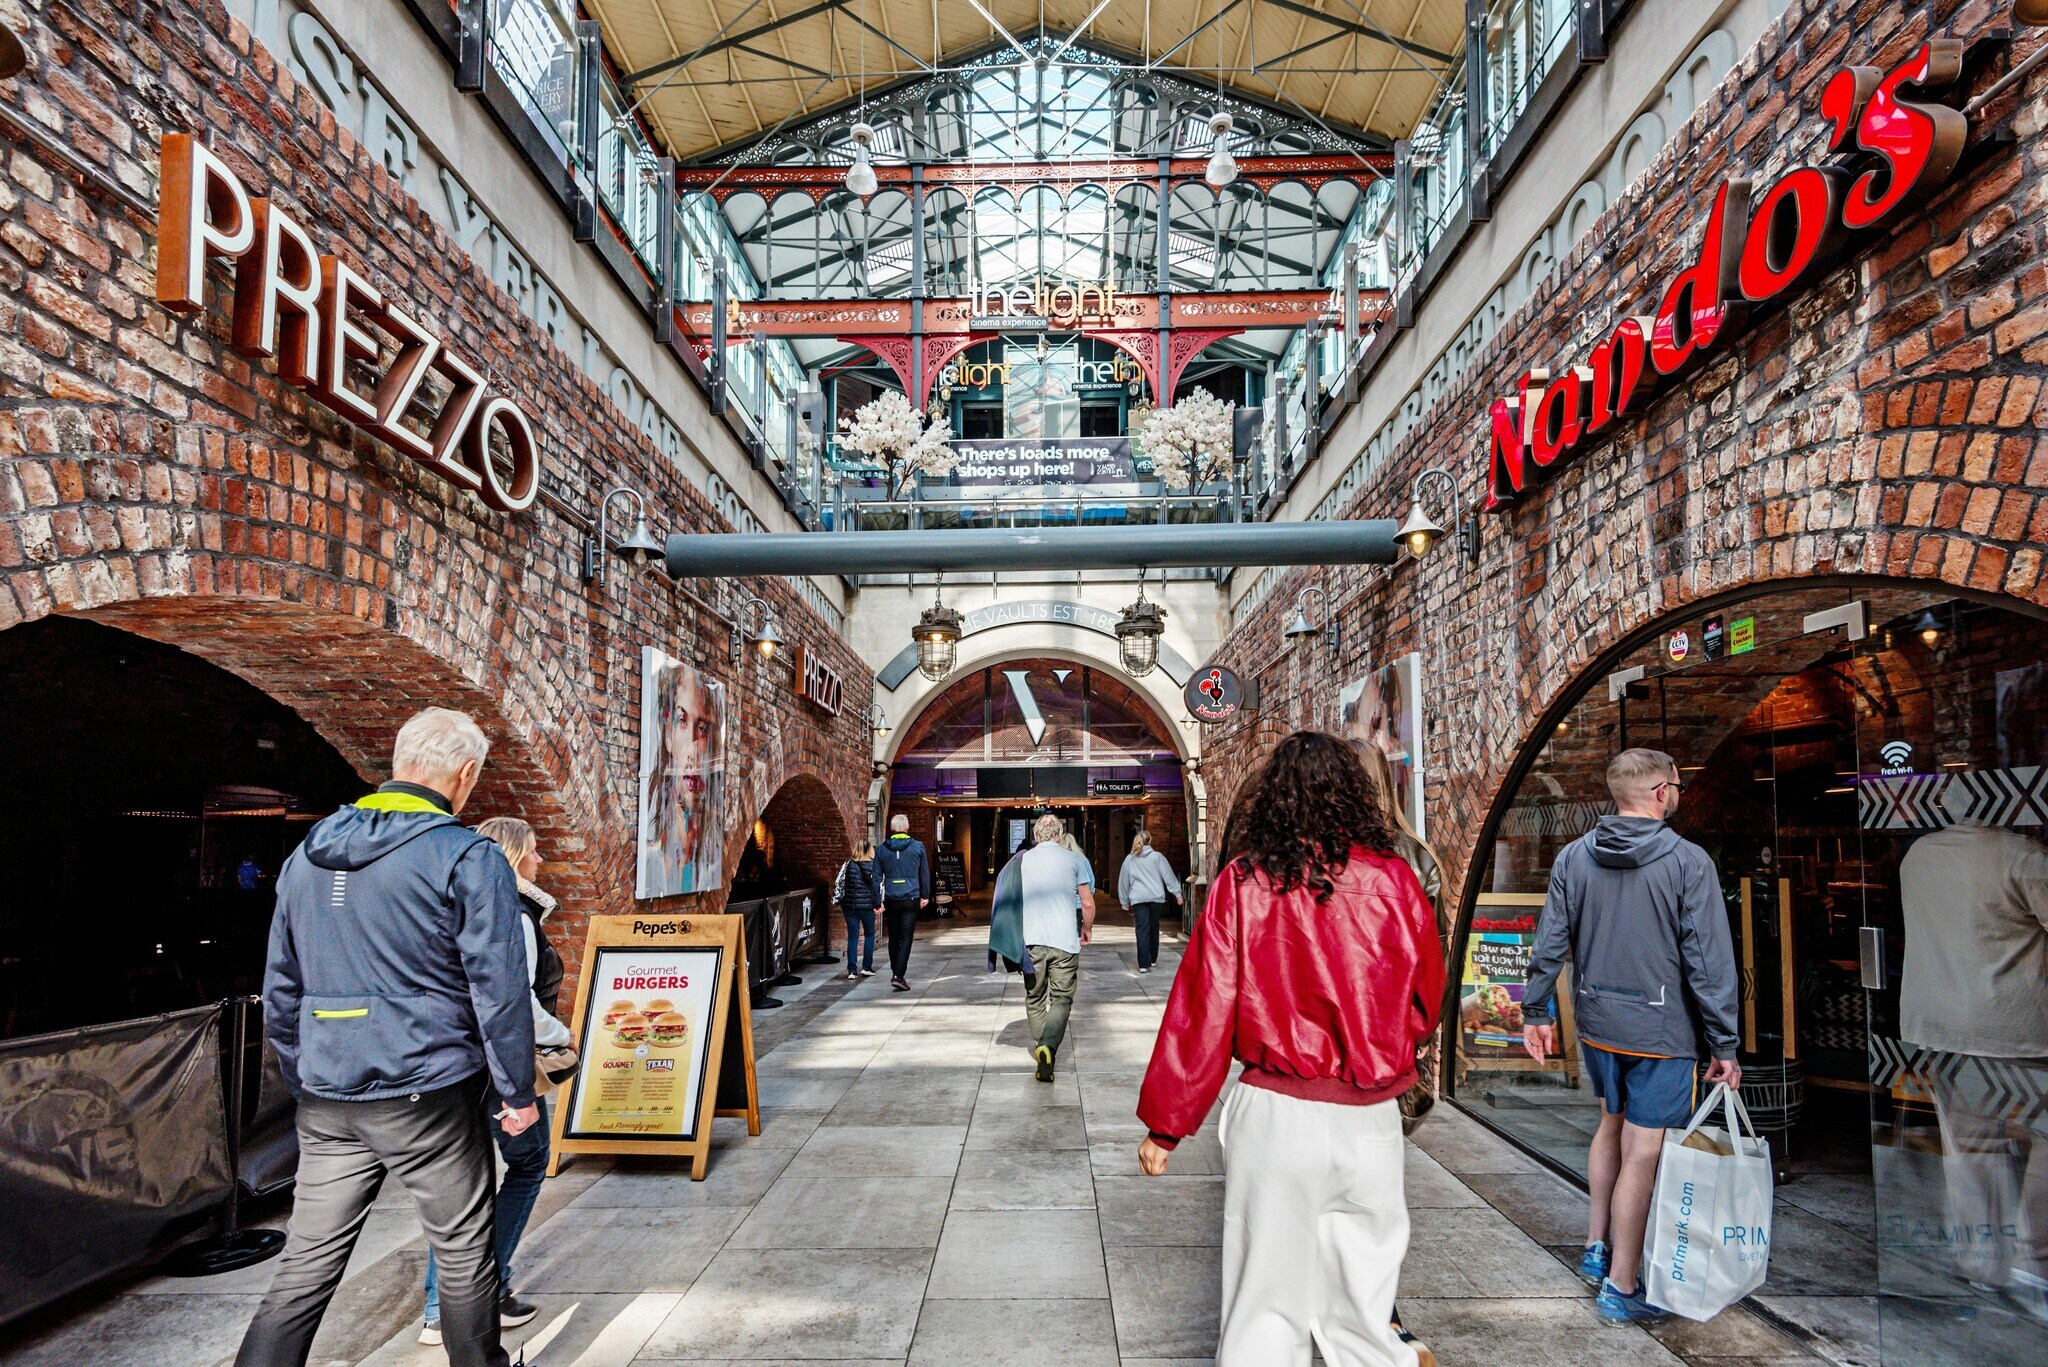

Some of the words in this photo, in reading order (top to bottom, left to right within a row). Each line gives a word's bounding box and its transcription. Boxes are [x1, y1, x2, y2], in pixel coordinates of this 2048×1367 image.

[1484, 42, 1940, 513] Nando's
[187, 141, 540, 513] PREZZO
[971, 318, 1000, 326] cinema
[1002, 318, 1047, 328] experience
[959, 447, 1017, 461] There's
[1020, 446, 1064, 461] loads
[1067, 447, 1109, 460] more
[958, 463, 1006, 479] shops
[1009, 464, 1031, 479] up
[1034, 462, 1075, 476] here!
[961, 613, 982, 634] HE
[984, 603, 1047, 624] VAULTS
[1053, 604, 1083, 623] EST.
[1090, 612, 1116, 632] 185
[1671, 639, 1686, 649] CCTV
[803, 647, 844, 717] PREZZO
[1195, 703, 1236, 718] Nando's
[1881, 767, 1897, 776] Free
[1897, 766, 1913, 775] Wi-Fi
[633, 921, 677, 938] Pepe's
[627, 965, 678, 976] Gourmet
[613, 976, 689, 990] BURGERS
[603, 1061, 634, 1069] GOURMET
[646, 1059, 674, 1071] TEXAN
[1672, 1181, 1695, 1283] primark.com
